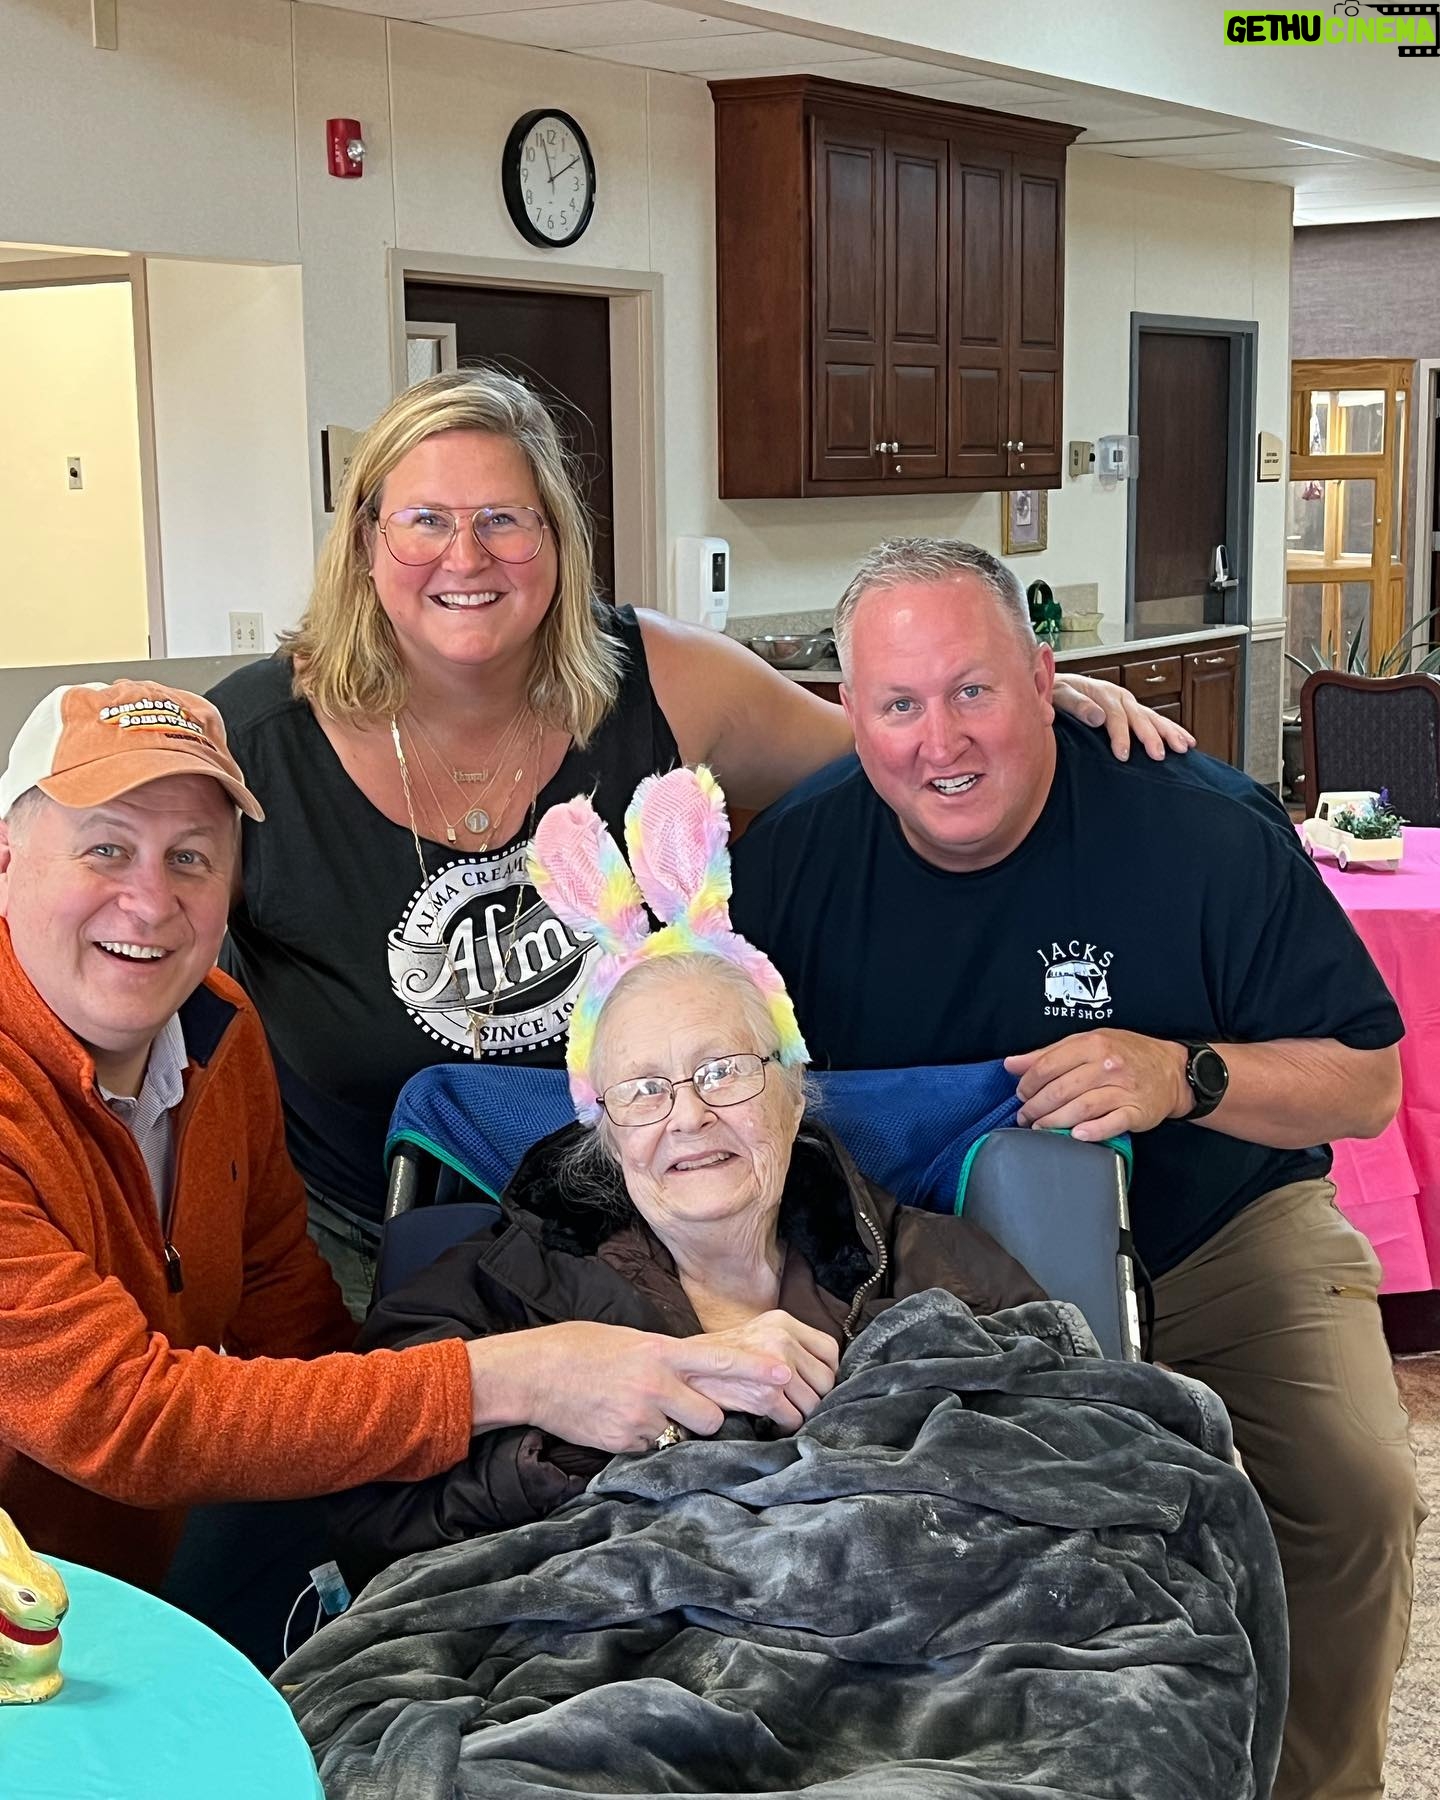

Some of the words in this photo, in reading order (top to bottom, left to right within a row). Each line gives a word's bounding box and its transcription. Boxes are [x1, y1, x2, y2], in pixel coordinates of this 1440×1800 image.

[535, 132, 543, 148] 11
[546, 129, 557, 146] 12
[525, 146, 536, 162] 10
[521, 168, 529, 184] 9
[573, 177, 580, 192] 3
[525, 189, 533, 206] 8
[569, 198, 576, 212] 4
[535, 208, 543, 223] 7
[546, 215, 555, 230] 6
[560, 210, 568, 226] 5
[99, 699, 181, 720] Somebody
[401, 903, 594, 1001] Alm
[1037, 940, 1114, 967] JACKS
[479, 1017, 547, 1042] SINCE
[552, 1000, 576, 1025] 19
